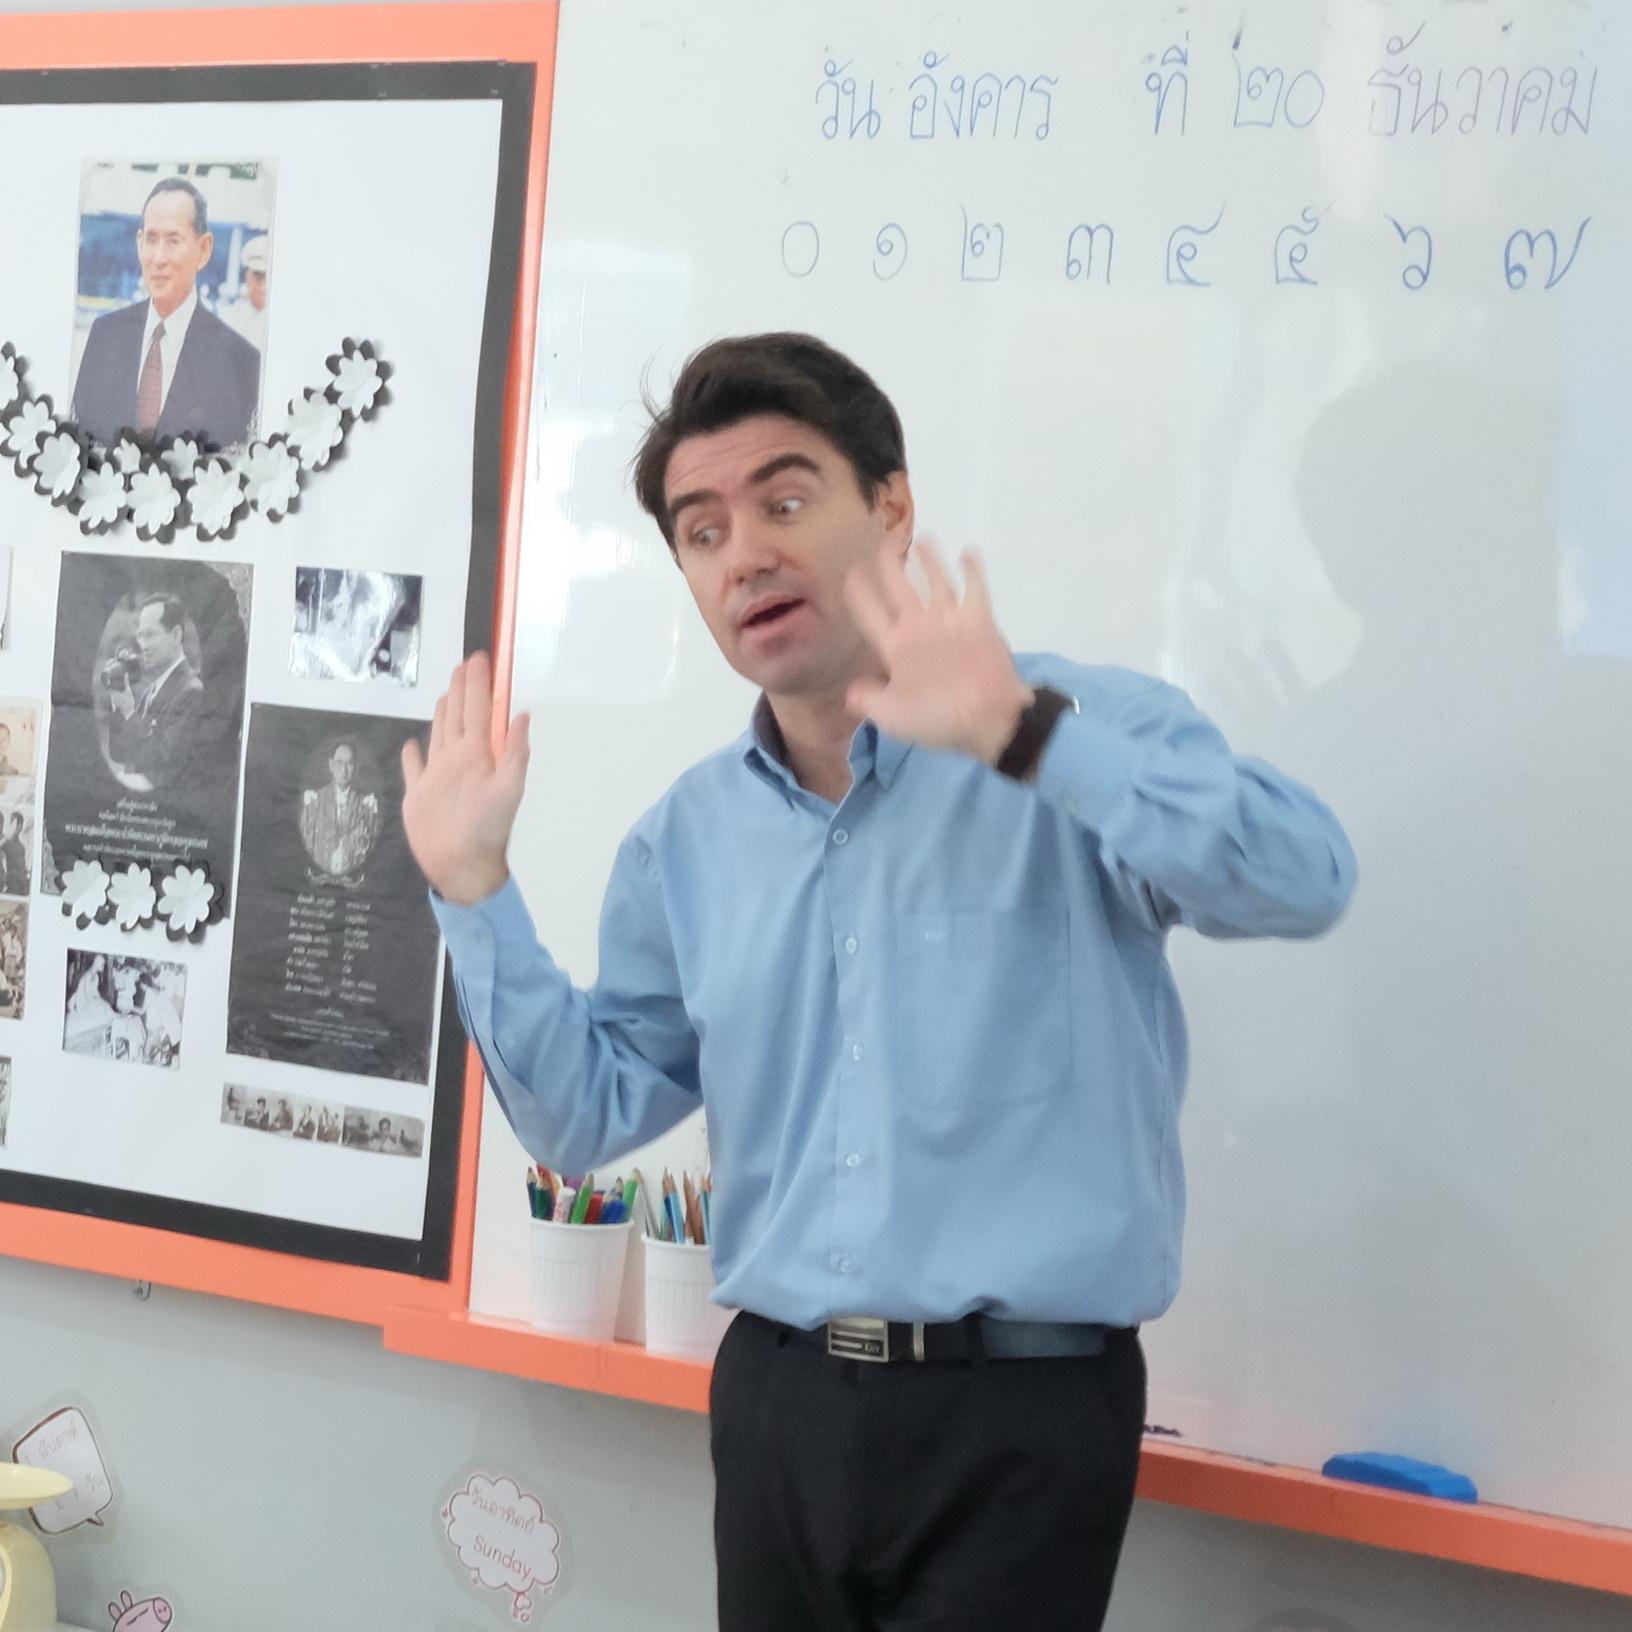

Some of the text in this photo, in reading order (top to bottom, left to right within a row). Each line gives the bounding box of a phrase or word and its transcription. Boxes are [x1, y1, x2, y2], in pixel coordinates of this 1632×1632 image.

[815, 59, 881, 140] วัน
[909, 49, 1059, 140] อังคาร
[1145, 31, 1189, 136] ที่
[1367, 22, 1598, 136] ธันวาคม
[873, 222, 908, 281] ๑
[960, 203, 1004, 282] ๒
[1066, 223, 1114, 284] ๓
[1166, 201, 1226, 287] ๔
[1274, 203, 1328, 286] ๕
[1384, 214, 1432, 290] ๖
[1504, 217, 1593, 290] ๗
[473, 1534, 533, 1582] Sunday
